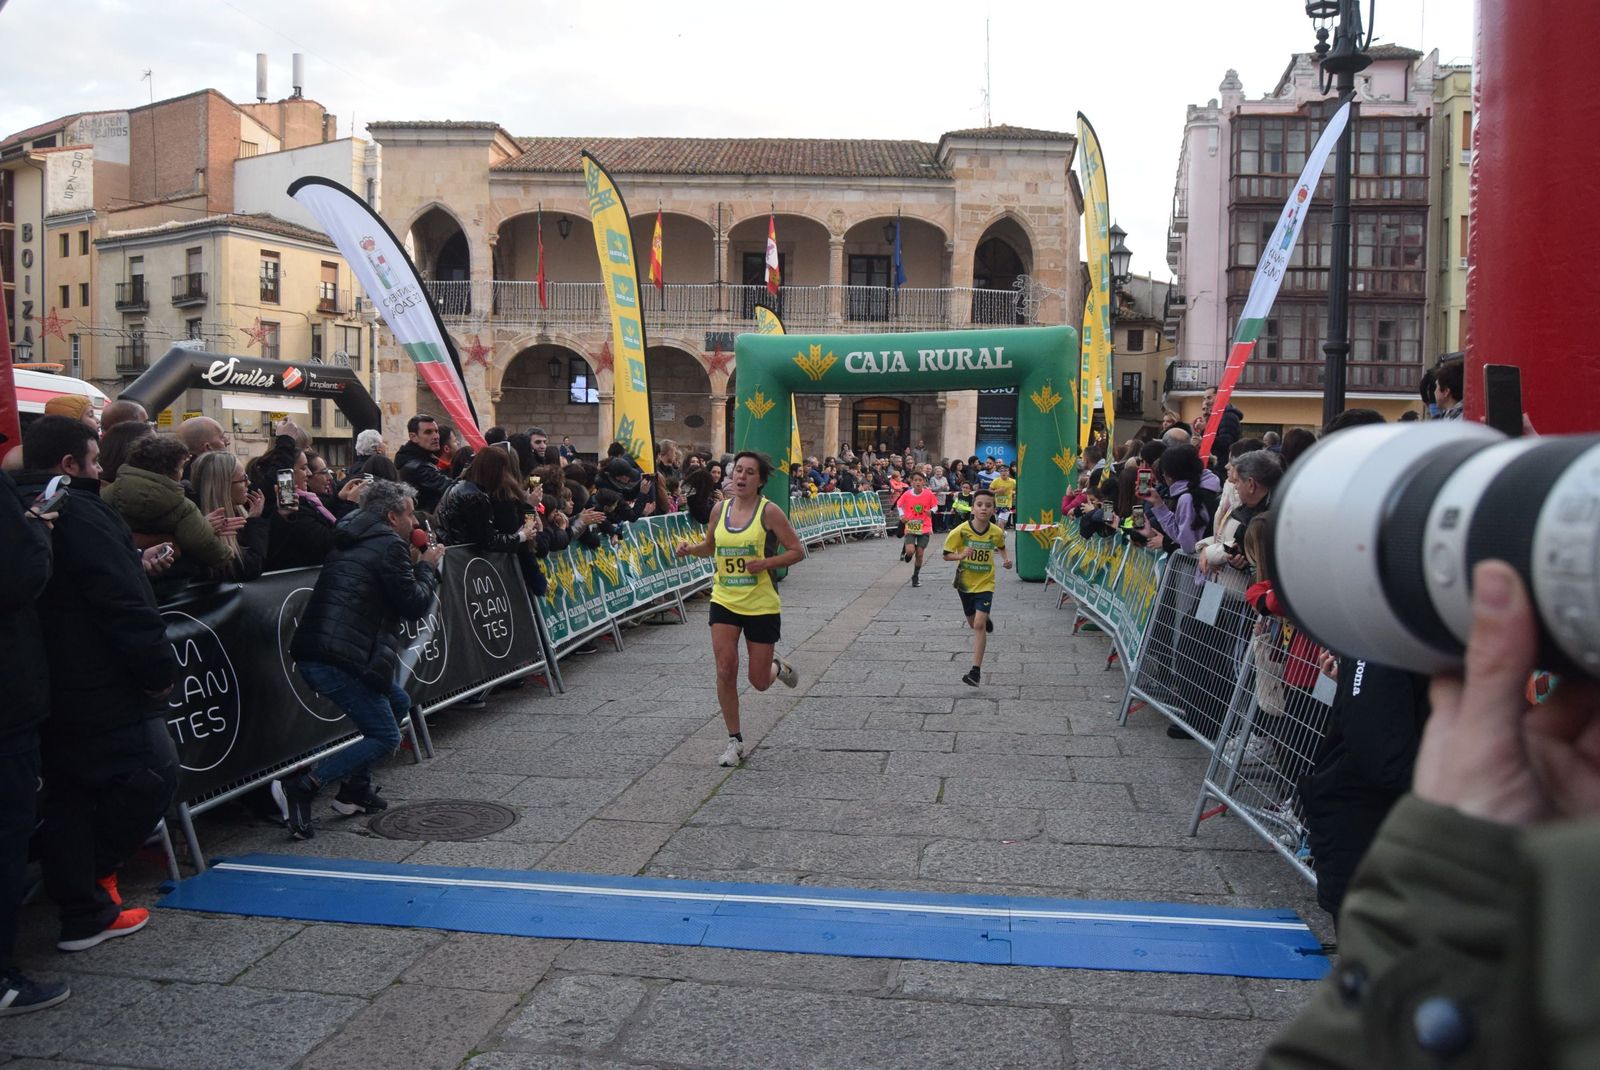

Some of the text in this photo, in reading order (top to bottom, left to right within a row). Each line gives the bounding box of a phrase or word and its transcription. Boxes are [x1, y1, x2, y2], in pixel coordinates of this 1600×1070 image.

[91, 127, 128, 138] TEJIDOS
[64, 152, 83, 199] BOIZAS
[22, 223, 34, 358] BOIZA
[202, 357, 275, 387] Smiles
[845, 347, 1013, 374] CAJA RURAL
[986, 446, 1004, 456] 016
[725, 558, 746, 574] 59
[473, 576, 494, 595] IM
[482, 619, 508, 640] TES
[171, 639, 202, 667] M
[408, 639, 440, 663] TES
[169, 668, 228, 707] AN
[1353, 660, 1366, 697] Joma
[167, 706, 226, 743] TES
